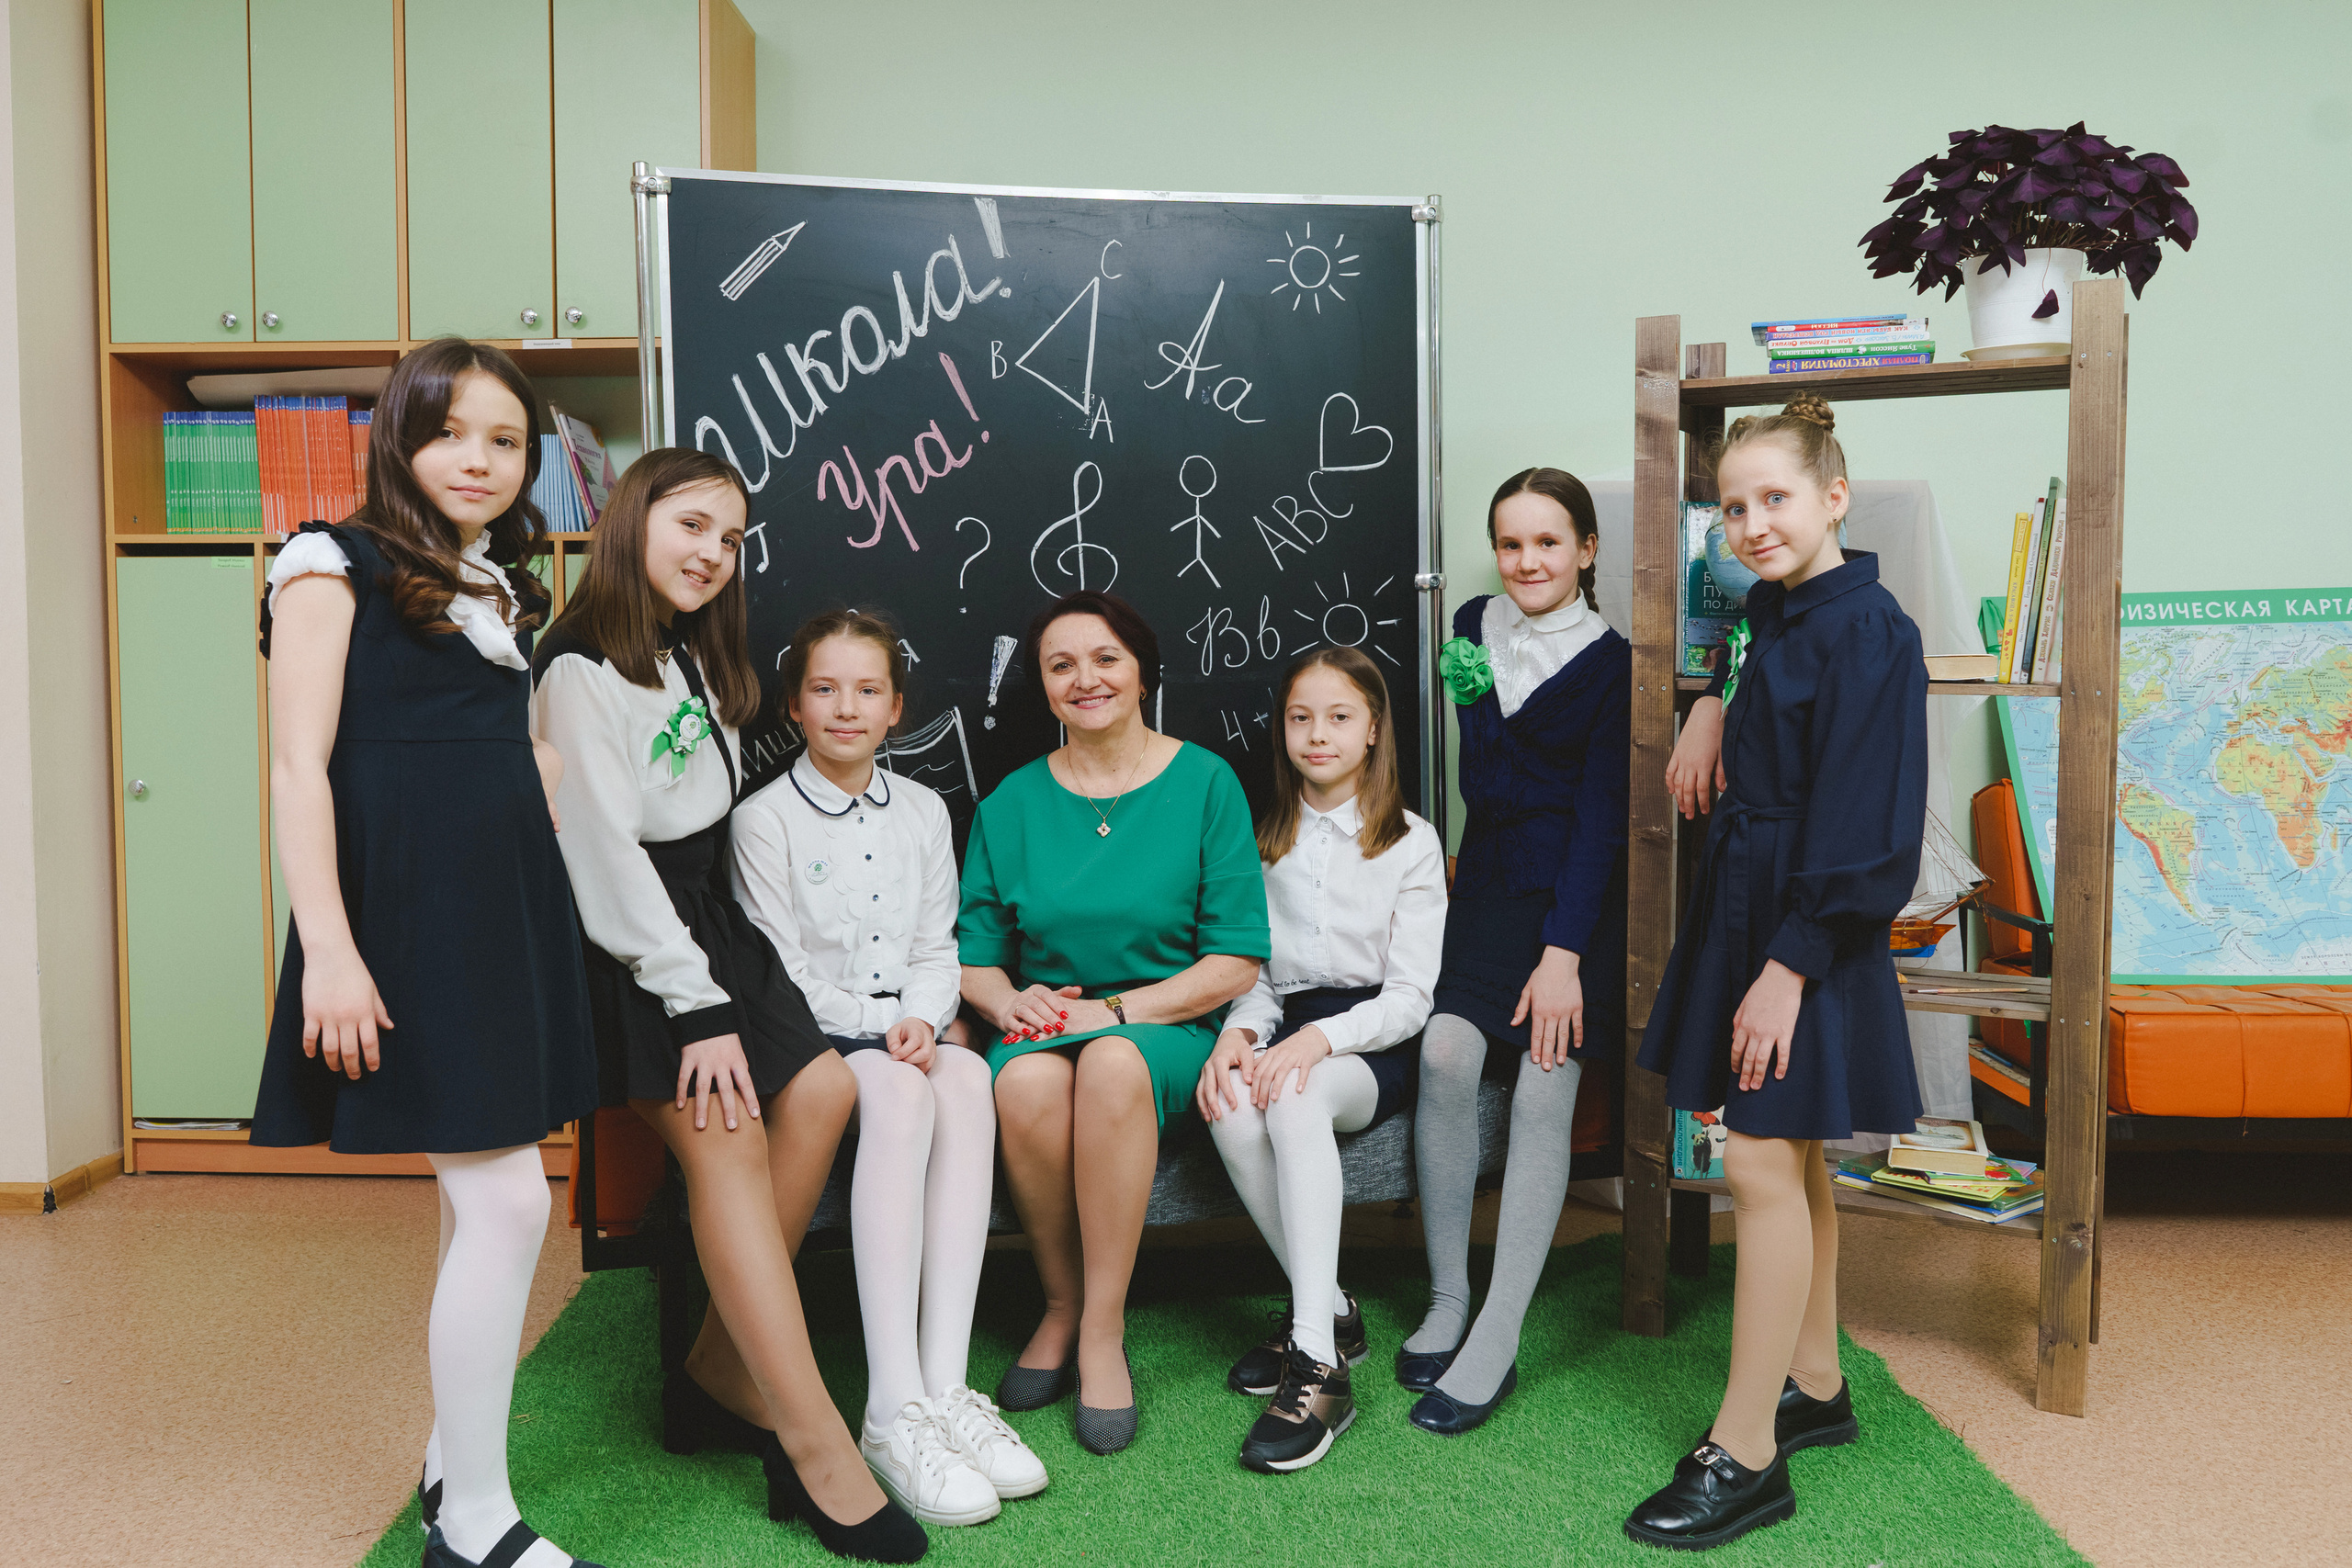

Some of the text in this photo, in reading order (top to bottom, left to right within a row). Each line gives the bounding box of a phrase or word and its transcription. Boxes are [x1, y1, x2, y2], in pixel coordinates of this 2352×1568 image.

[1871, 343, 1917, 353] Туве Янссон
[1801, 355, 1919, 370] ПОЛНАЯ ХРЕСТОМАТИЯ
[817, 352, 990, 552] Ура!
